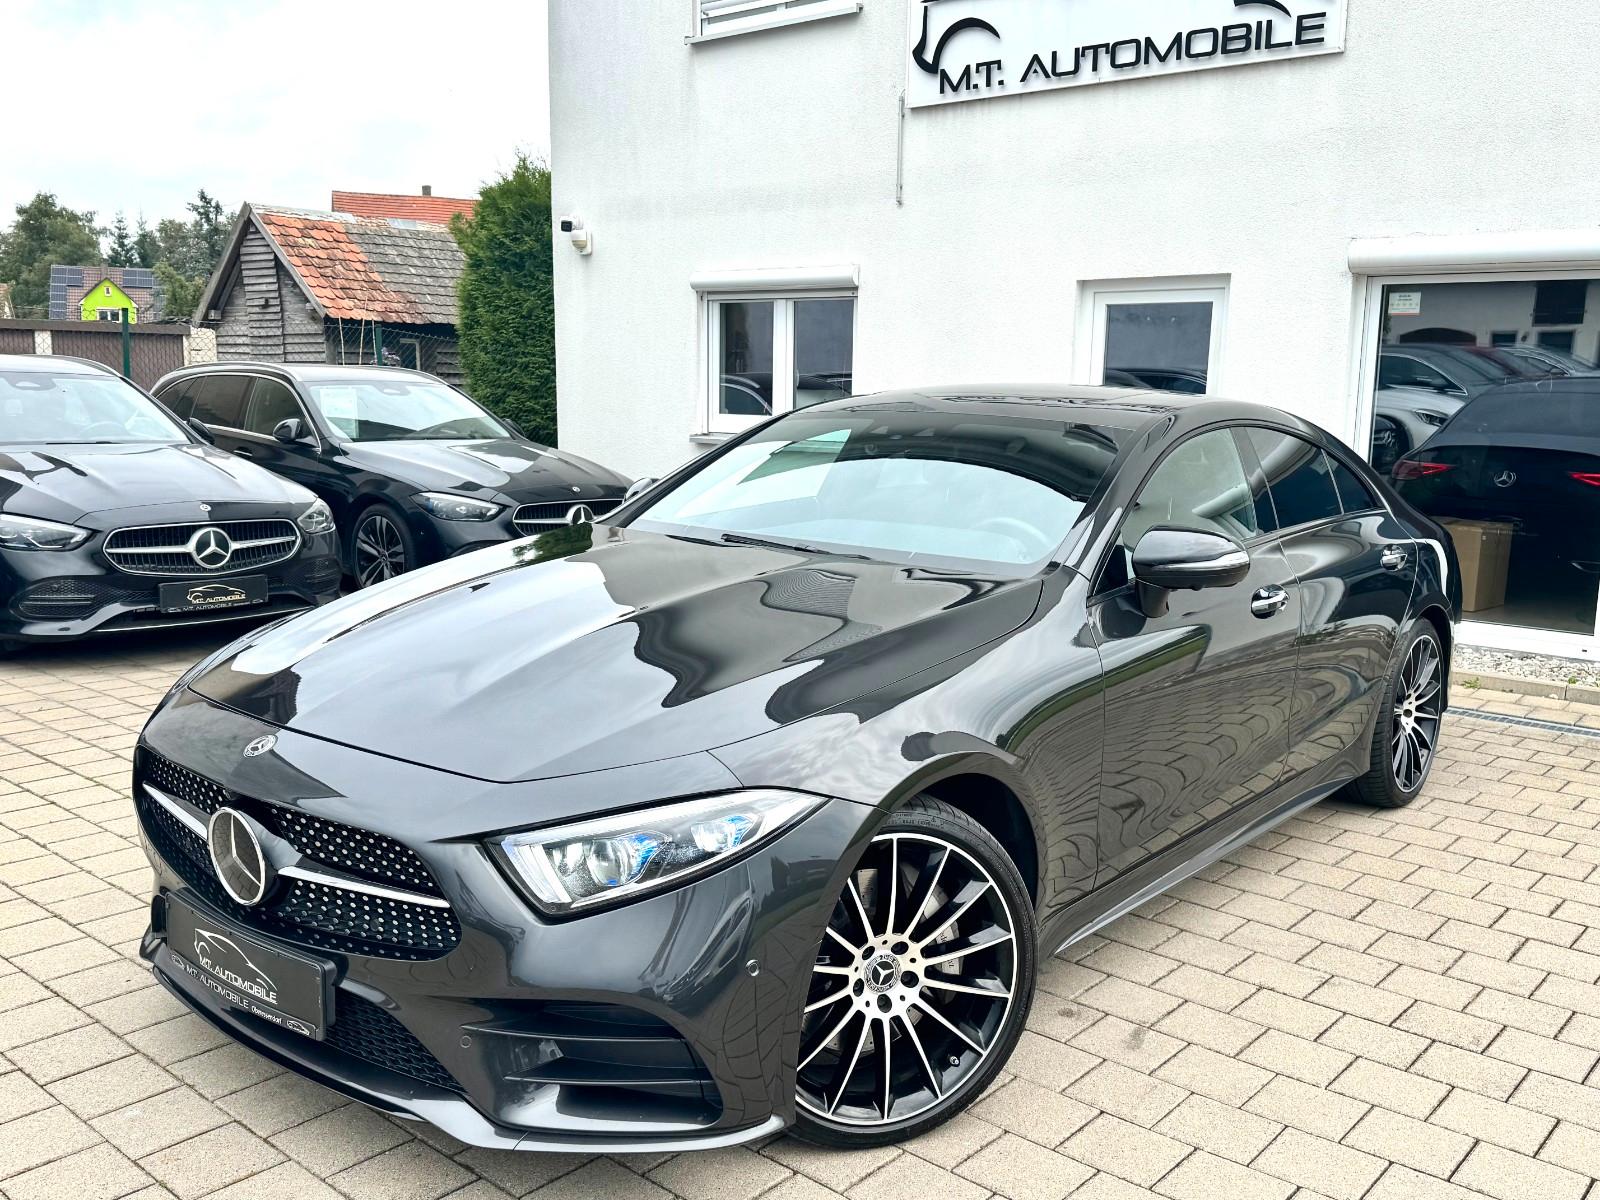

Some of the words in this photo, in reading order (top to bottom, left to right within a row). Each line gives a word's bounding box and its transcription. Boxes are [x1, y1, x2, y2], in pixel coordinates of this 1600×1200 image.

[939, 59, 1004, 94] M.T.
[1019, 11, 1327, 83] AUTOMOBILE
[200, 974, 249, 1009] AUTOMOBILE
[214, 965, 277, 1004] AUTOMOBILE
